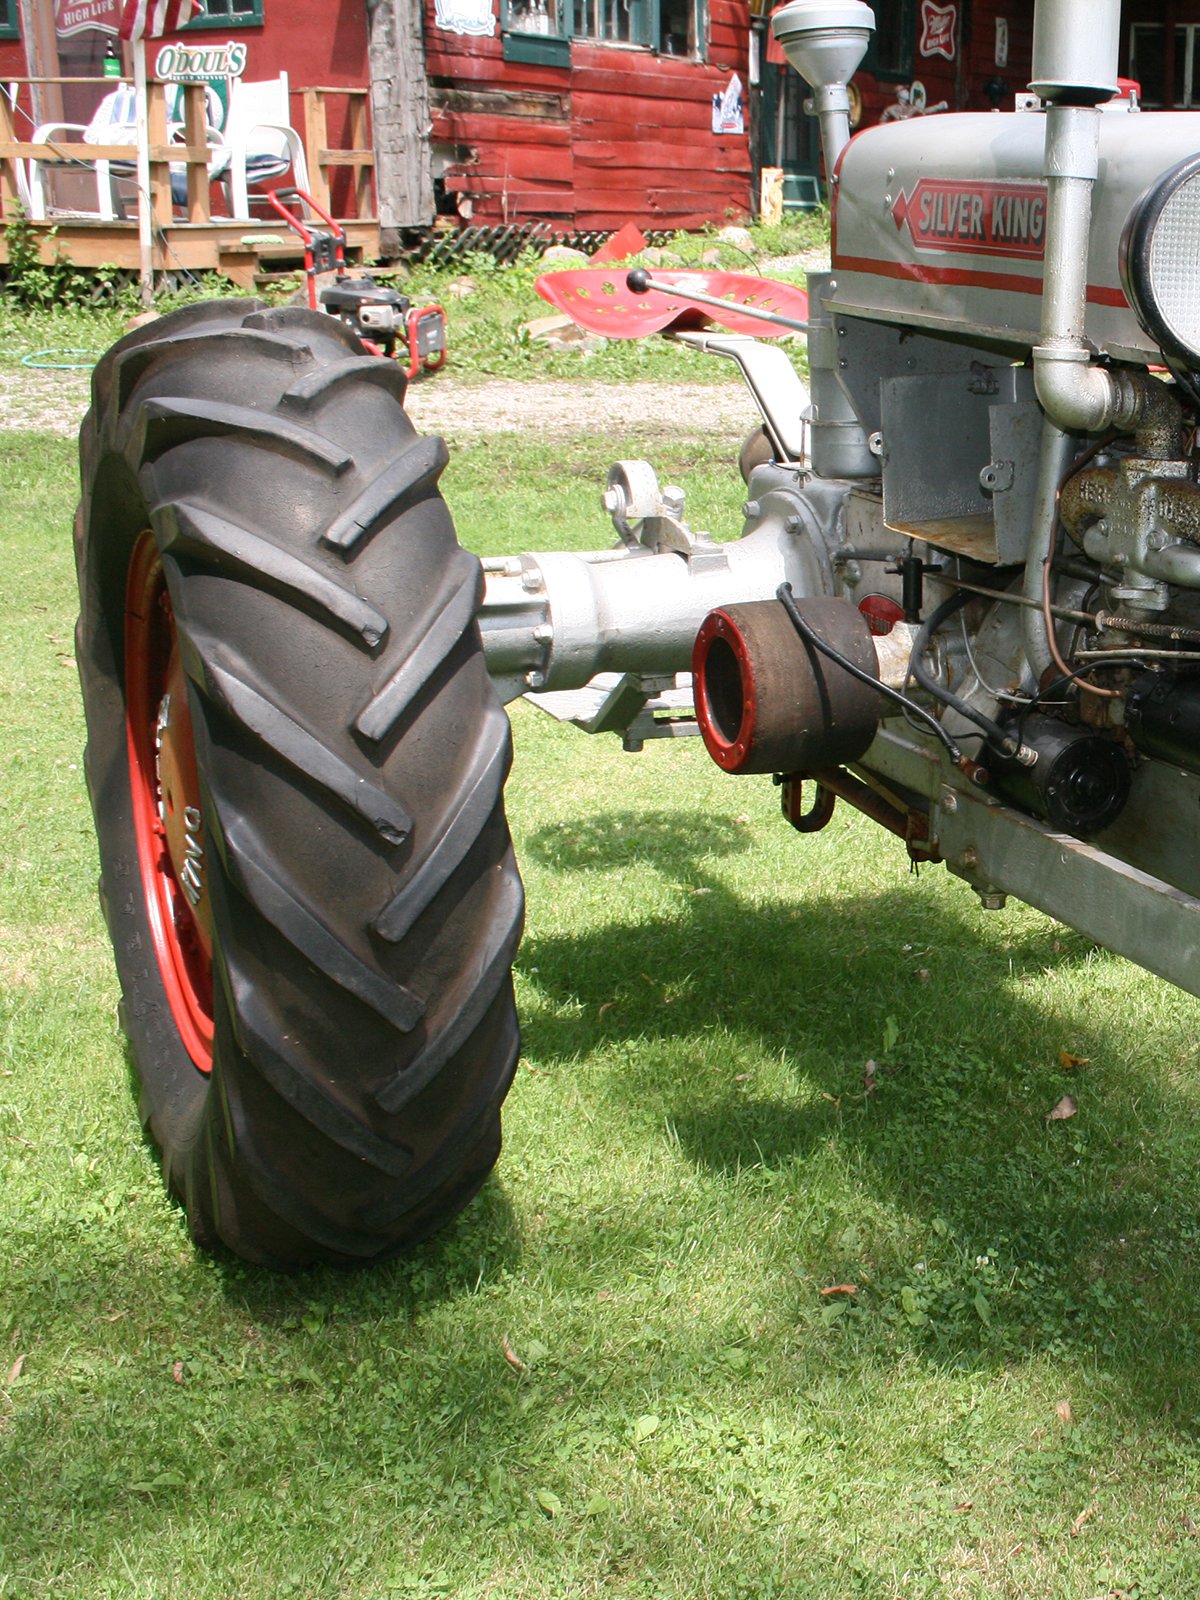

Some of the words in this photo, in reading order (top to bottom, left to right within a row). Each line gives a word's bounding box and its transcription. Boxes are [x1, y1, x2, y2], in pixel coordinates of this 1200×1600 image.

[63, 7, 90, 26] HIGH
[91, 0, 115, 16] LIFE
[157, 44, 245, 77] O'DOUL'S
[917, 190, 985, 240] SILVER
[991, 194, 1046, 246] KING
